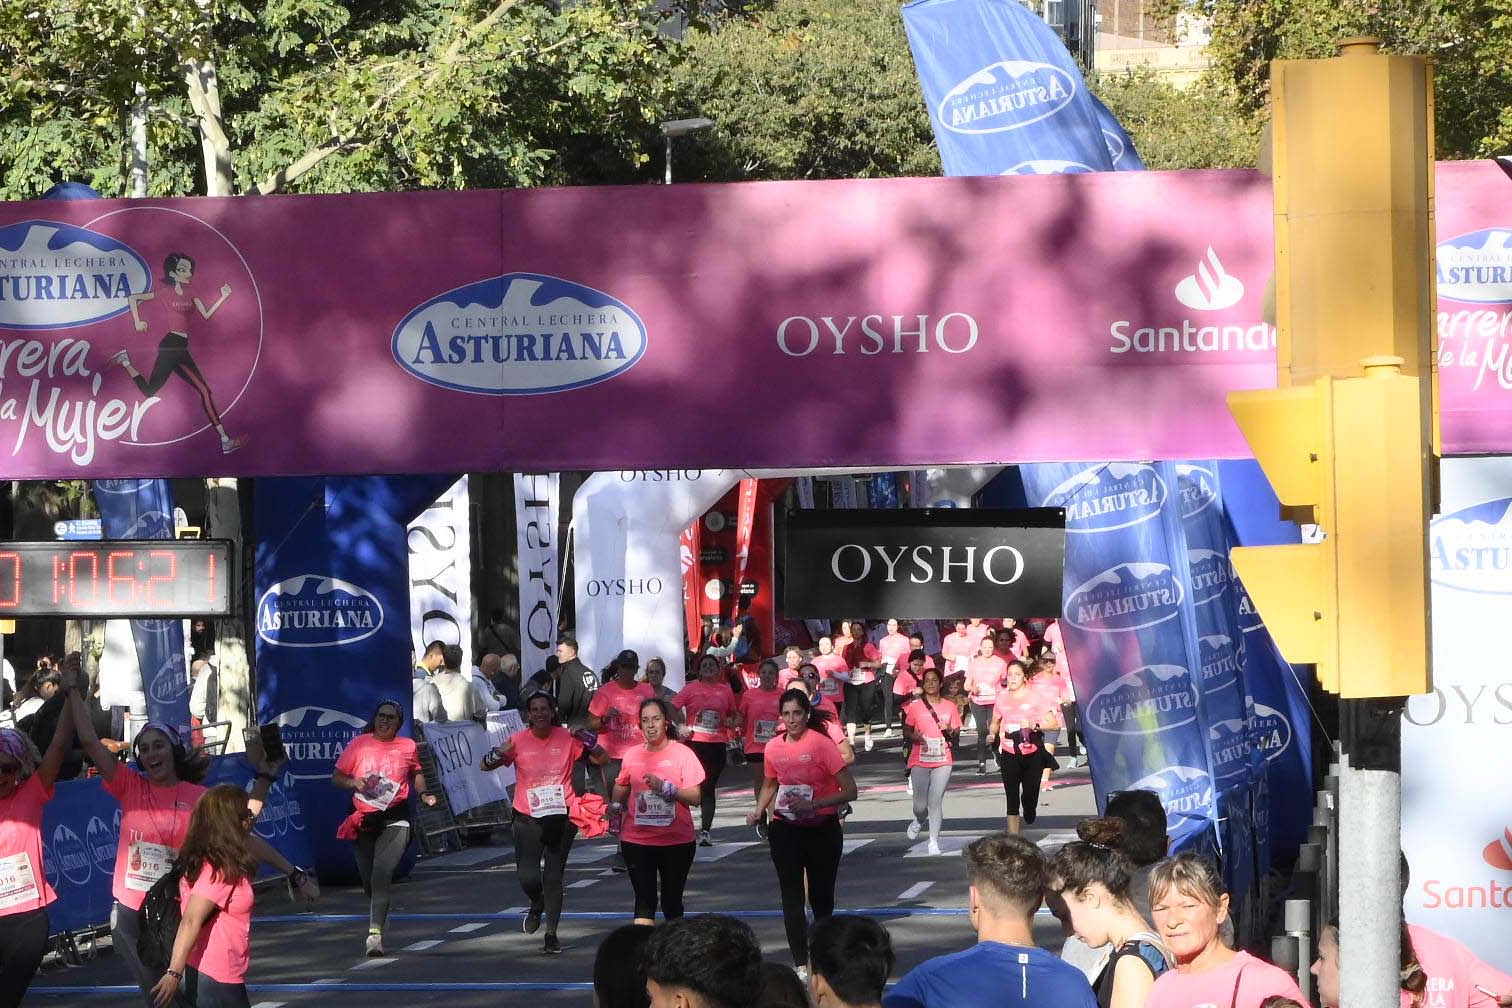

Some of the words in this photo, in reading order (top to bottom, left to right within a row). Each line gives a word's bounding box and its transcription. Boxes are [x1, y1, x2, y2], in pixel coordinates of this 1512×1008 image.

[54, 257, 126, 269] LECHERA
[451, 314, 531, 329] CENTRAL
[537, 312, 619, 326] LECHERA
[776, 311, 979, 356] OYSHO
[1110, 320, 1277, 354] Santand
[411, 320, 627, 364] ASTURIANA
[12, 374, 163, 467] Mujer
[831, 544, 1025, 585] OYSHO
[586, 576, 663, 597] OYSHO
[260, 603, 375, 632] ASTURIANA
